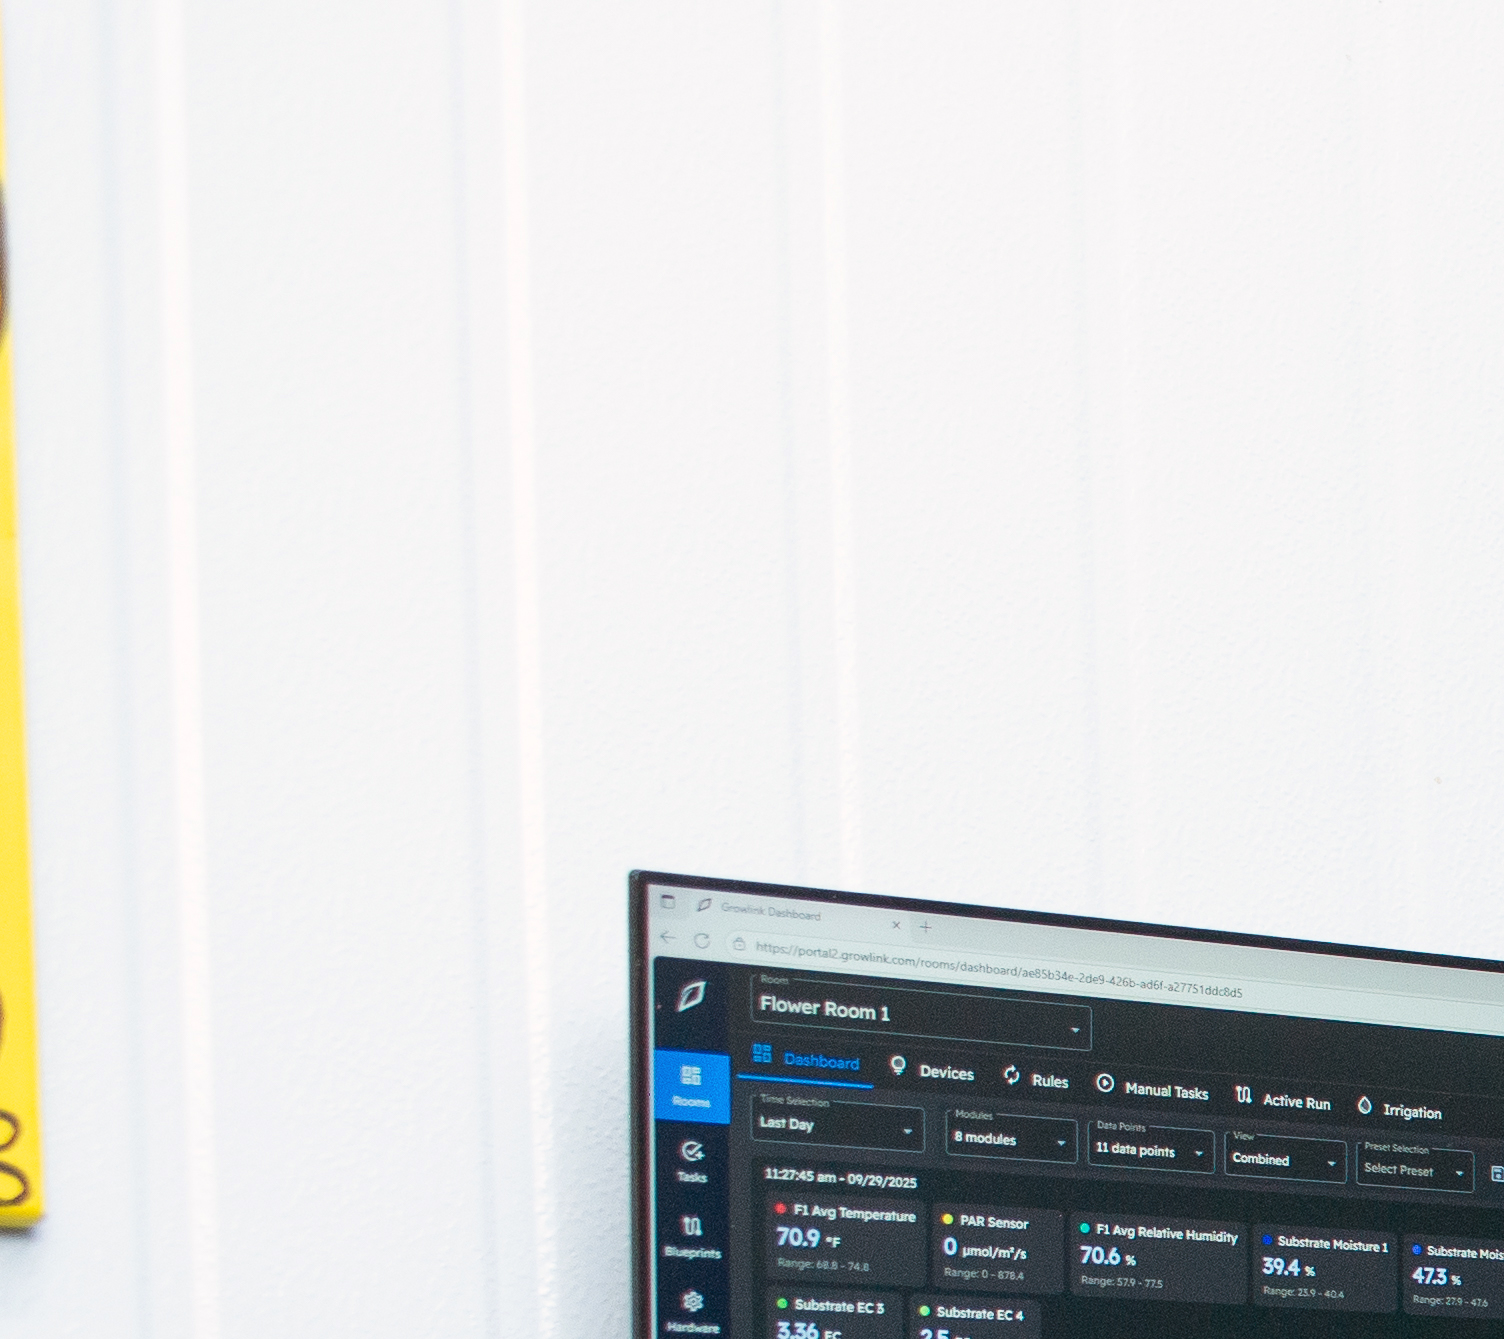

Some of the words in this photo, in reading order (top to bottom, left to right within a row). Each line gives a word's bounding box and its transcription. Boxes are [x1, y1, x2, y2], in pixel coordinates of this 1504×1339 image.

[759, 995, 821, 1015] Flower
[823, 1001, 876, 1020] Room
[880, 1006, 890, 1021] 1
[784, 1051, 860, 1071] Dashboard
[919, 1064, 974, 1081] Devices
[1030, 1073, 1069, 1089] Rules
[1124, 1082, 1171, 1097] Manual
[1174, 1086, 1209, 1100] Tasks
[1263, 1094, 1303, 1108] Active
[1306, 1097, 1331, 1110] Run
[1383, 1104, 1442, 1120] Irrigation
[759, 1116, 787, 1128] Last
[788, 1117, 814, 1133] Day
[953, 1130, 963, 1142] 8
[964, 1133, 1017, 1146] modules
[1231, 1152, 1290, 1166] Combined
[792, 1204, 809, 1216] F1
[811, 1205, 836, 1220] Avg
[838, 1206, 916, 1222] Temperature
[960, 1214, 985, 1226] PAR
[987, 1216, 1029, 1229] Sensor
[777, 1226, 820, 1247] 70.9
[1080, 1245, 1121, 1265] 70.6
[1262, 1257, 1301, 1276] 39.4
